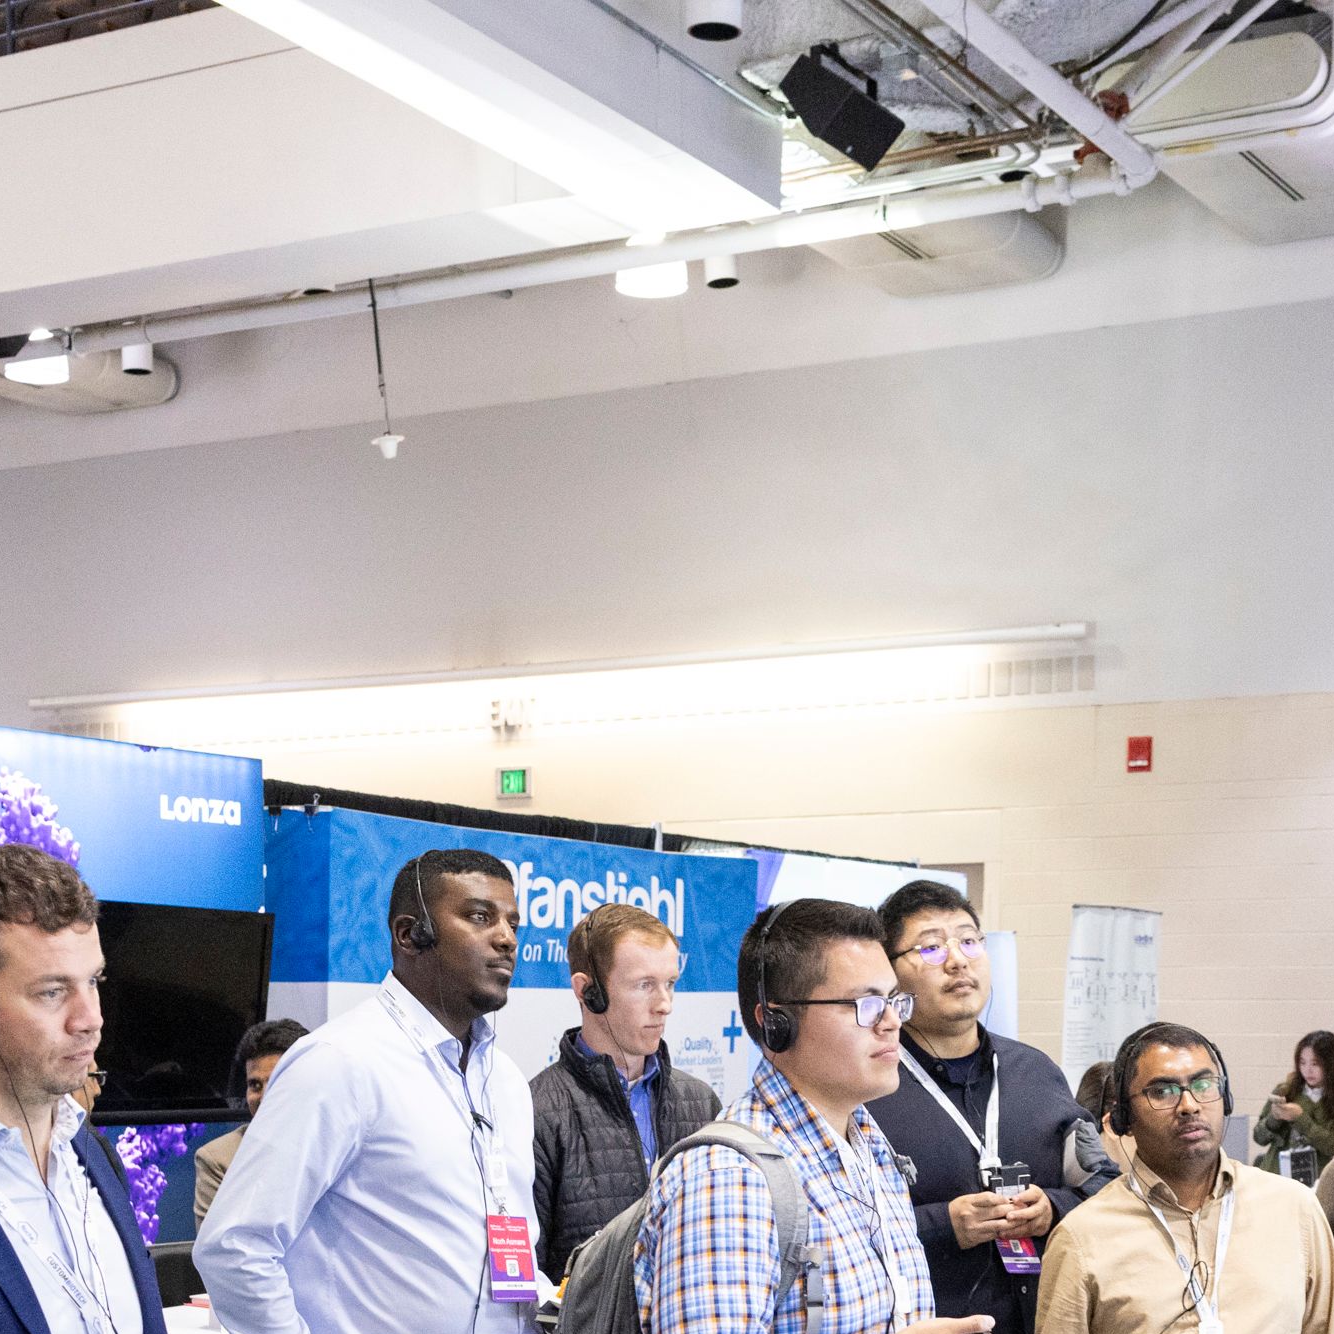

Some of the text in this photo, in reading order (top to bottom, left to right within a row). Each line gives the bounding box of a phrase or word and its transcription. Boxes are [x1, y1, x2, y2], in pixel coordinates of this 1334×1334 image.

[160, 794, 242, 826] Lonza
[503, 859, 685, 937] fansthl
[522, 944, 543, 962] on
[46, 1255, 87, 1306] CUSTOMBIOTECH
